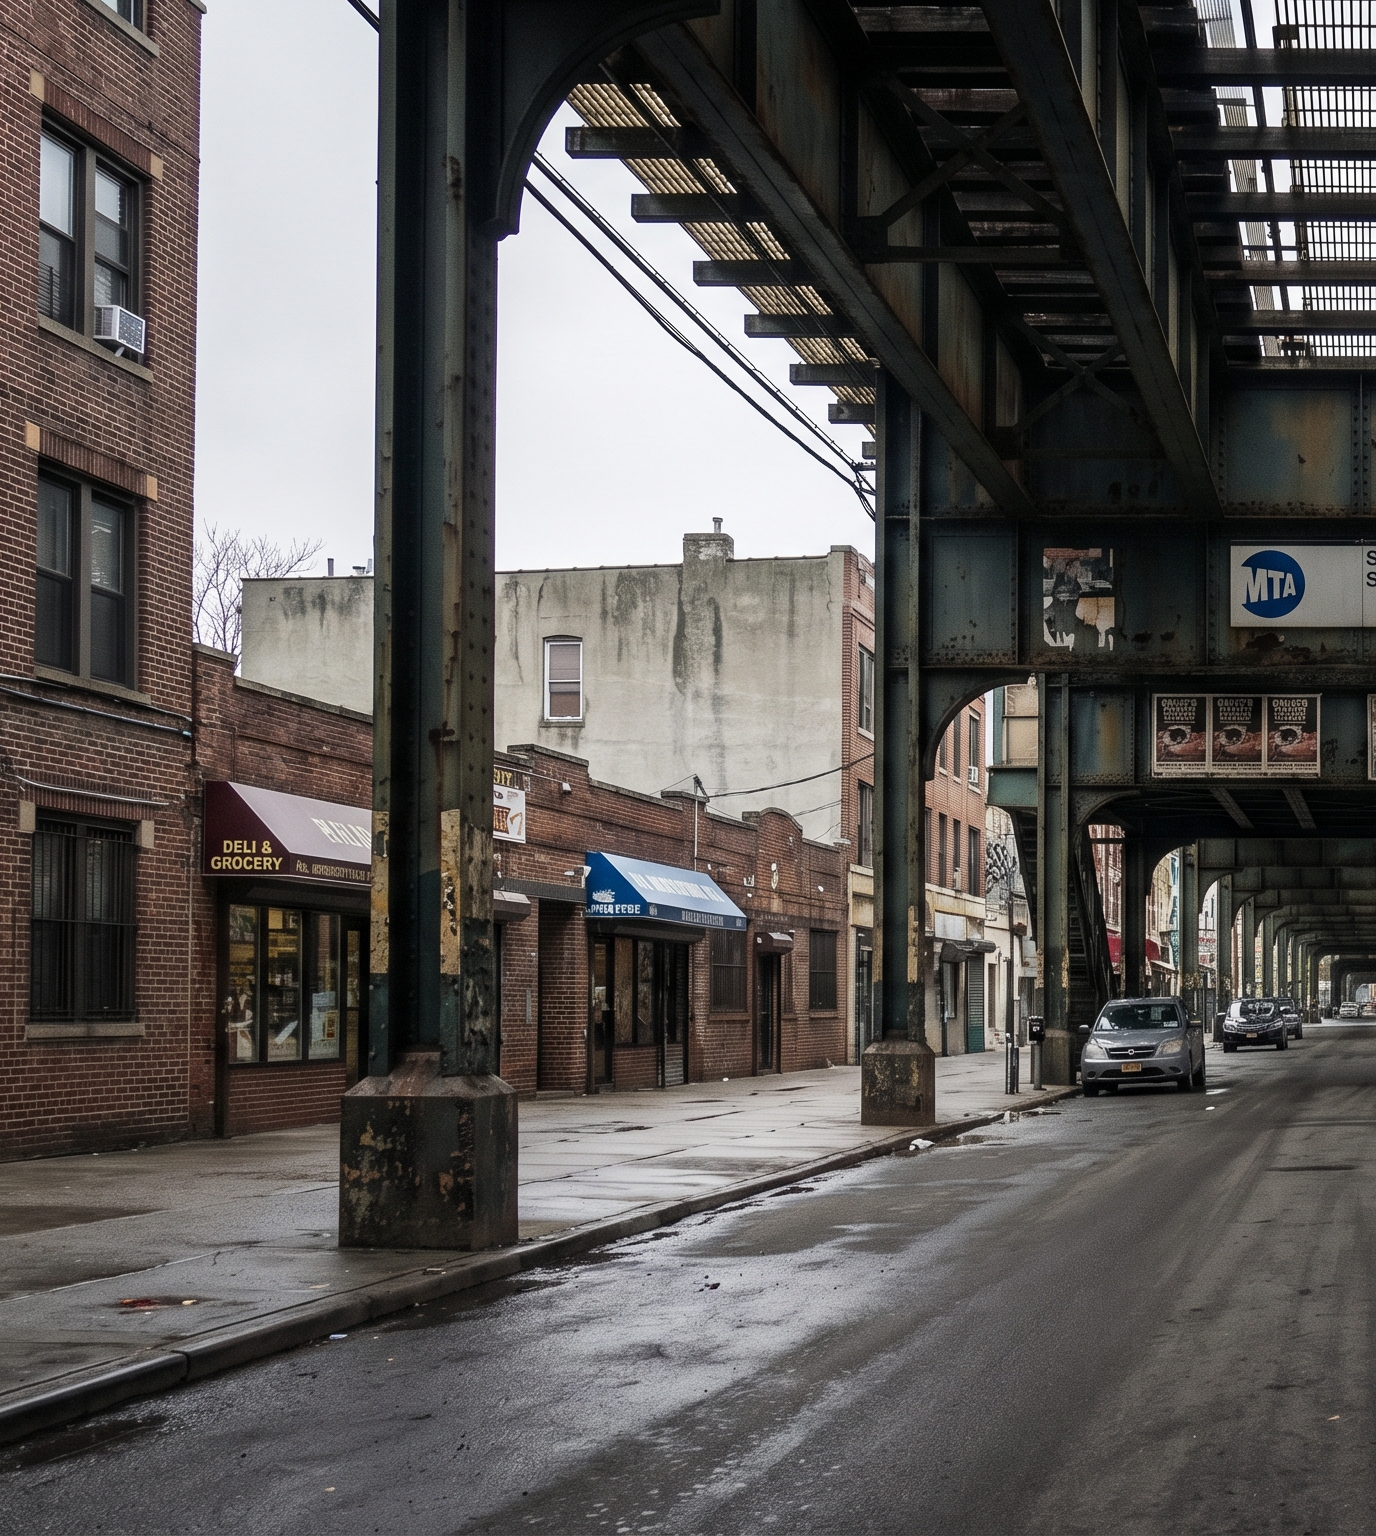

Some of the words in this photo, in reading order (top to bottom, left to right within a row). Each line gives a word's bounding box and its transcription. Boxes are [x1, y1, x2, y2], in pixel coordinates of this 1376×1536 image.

[1243, 567, 1297, 604] MTA
[223, 840, 256, 853] DELI
[262, 840, 272, 853] &
[211, 857, 283, 870] GROCERY
